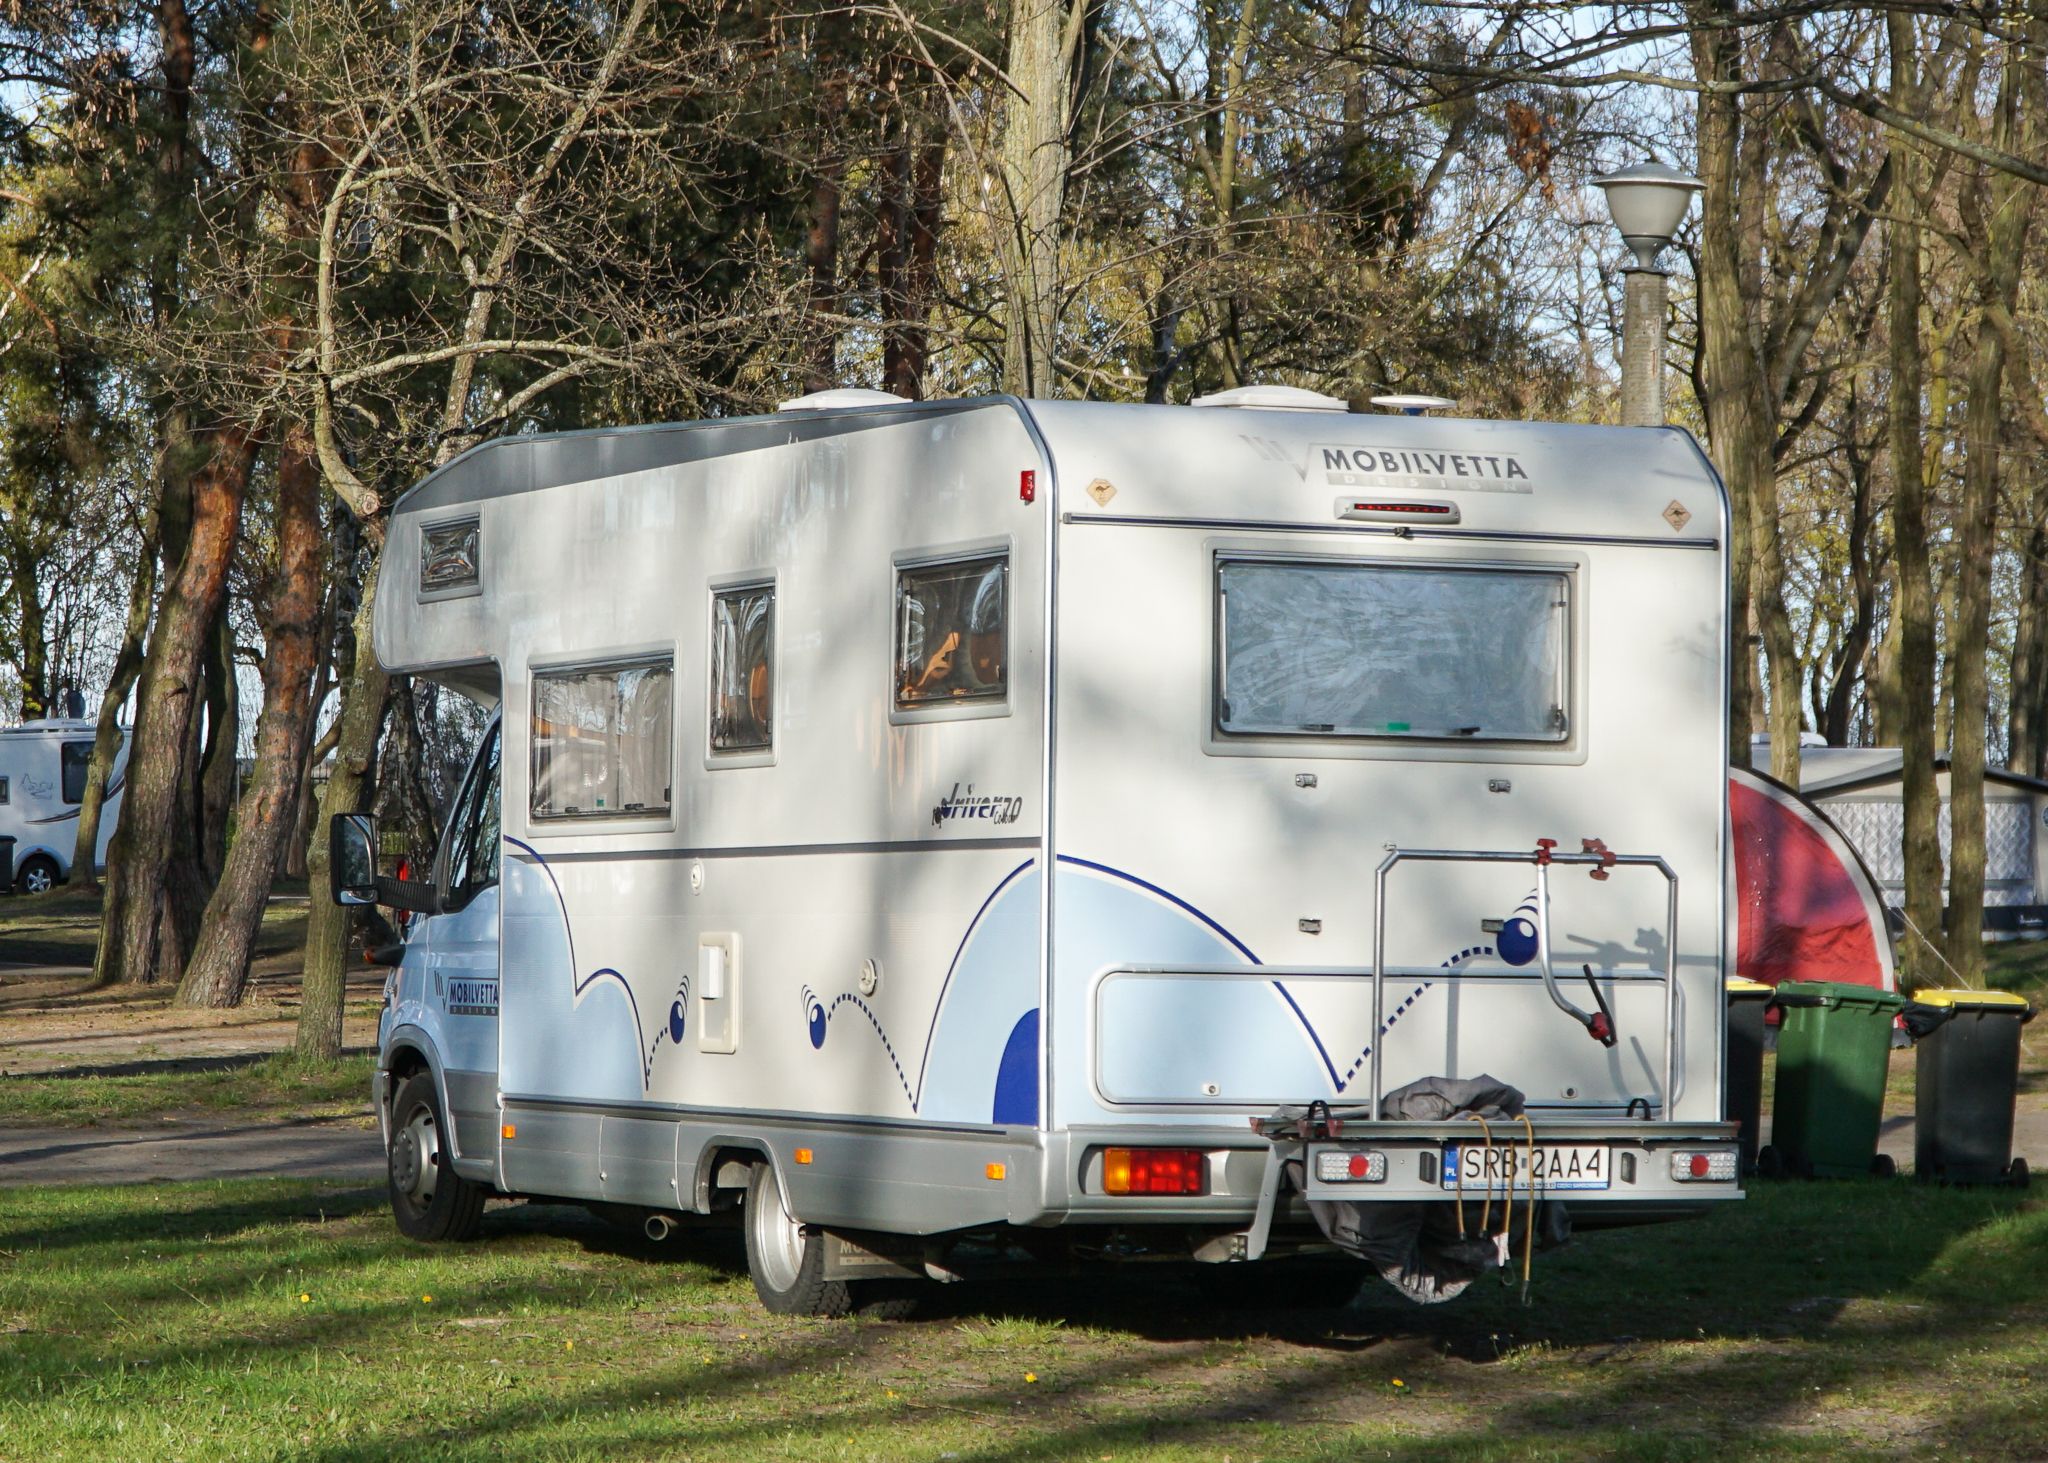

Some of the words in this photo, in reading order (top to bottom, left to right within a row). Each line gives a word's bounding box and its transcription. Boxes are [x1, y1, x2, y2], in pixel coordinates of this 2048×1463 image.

[1322, 448, 1529, 480] MOBILVETTA
[1343, 474, 1518, 492] DESIGN
[449, 982, 499, 1004] MOBILVETTA
[1444, 1167, 1458, 1177] PL
[1464, 1148, 1519, 1179] SRB
[1531, 1148, 1602, 1179] 2AA4
